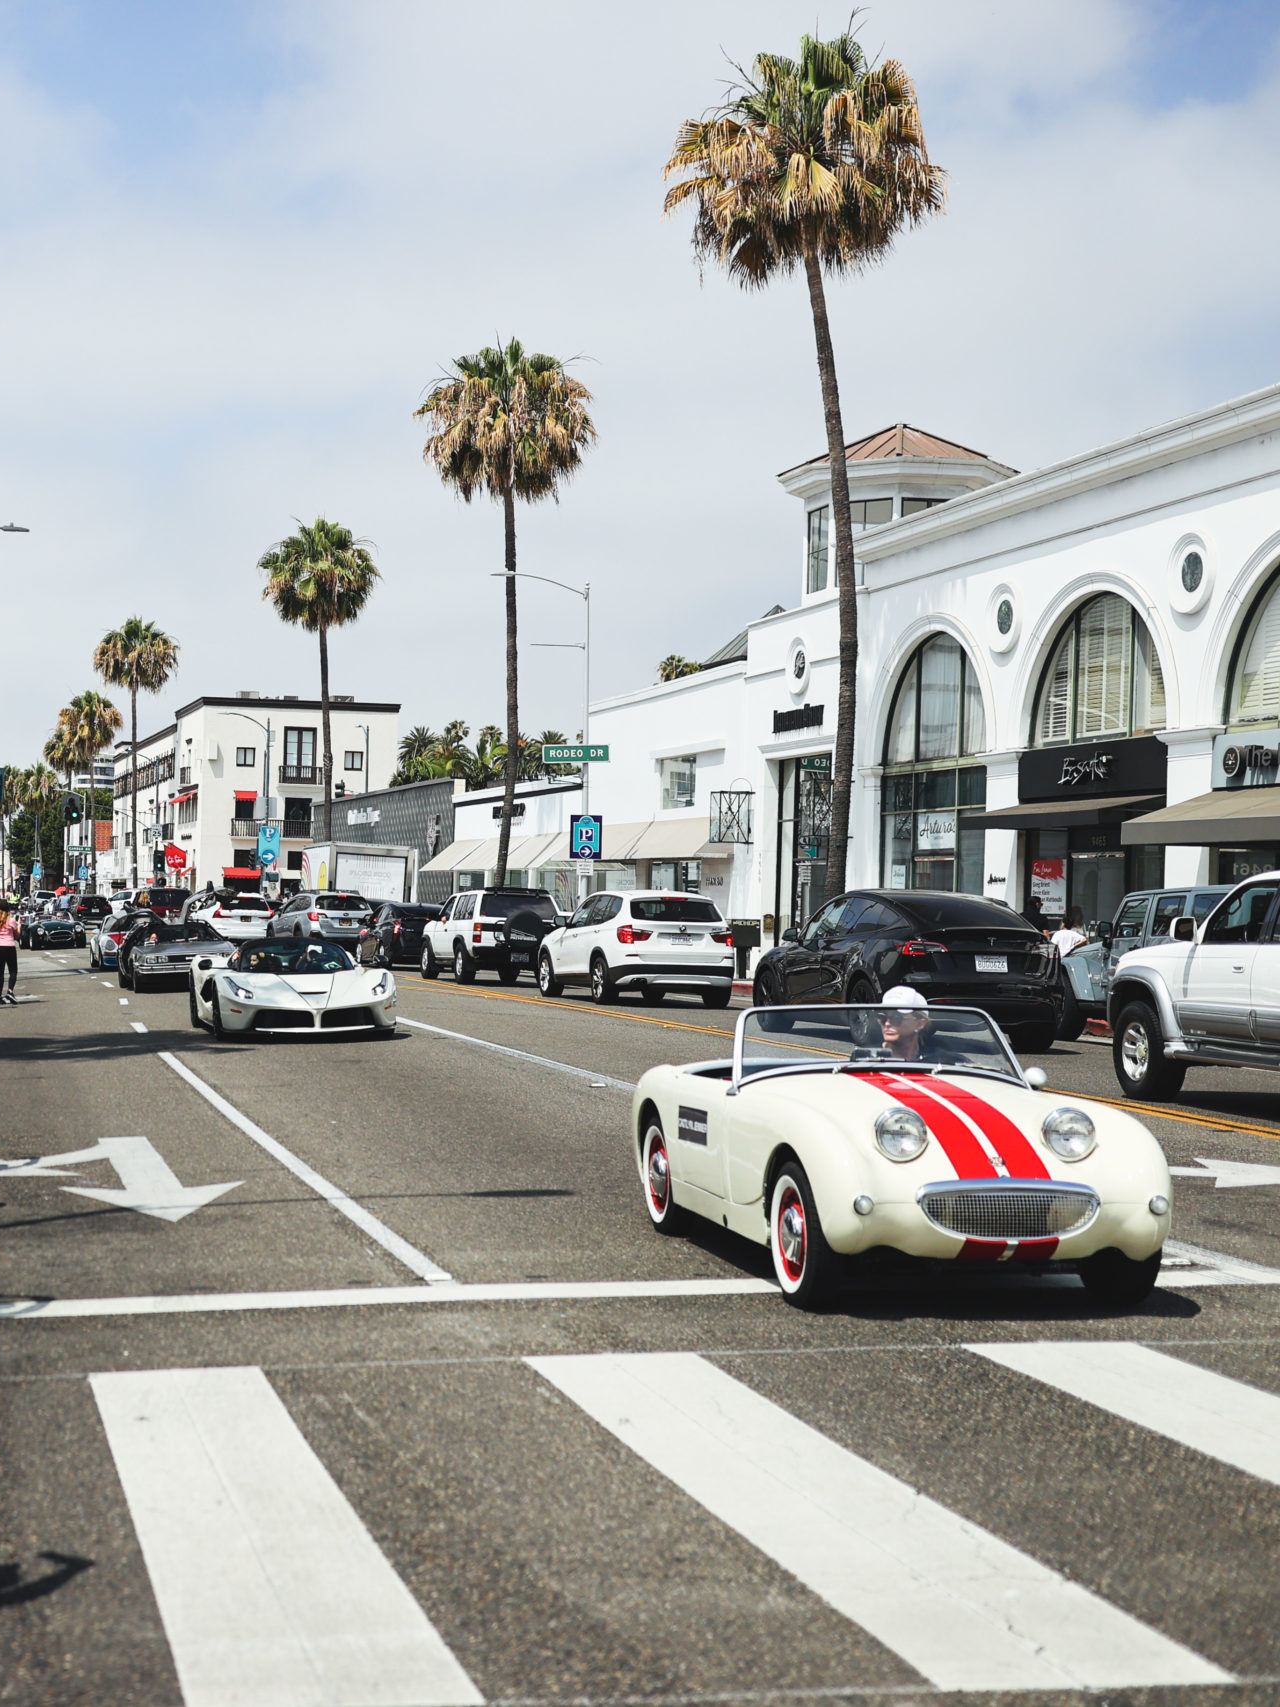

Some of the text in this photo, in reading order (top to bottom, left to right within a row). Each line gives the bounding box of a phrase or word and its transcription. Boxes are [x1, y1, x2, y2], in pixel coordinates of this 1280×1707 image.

[549, 749, 604, 758] RODEO DR
[266, 828, 275, 838] P
[581, 829, 592, 841] P
